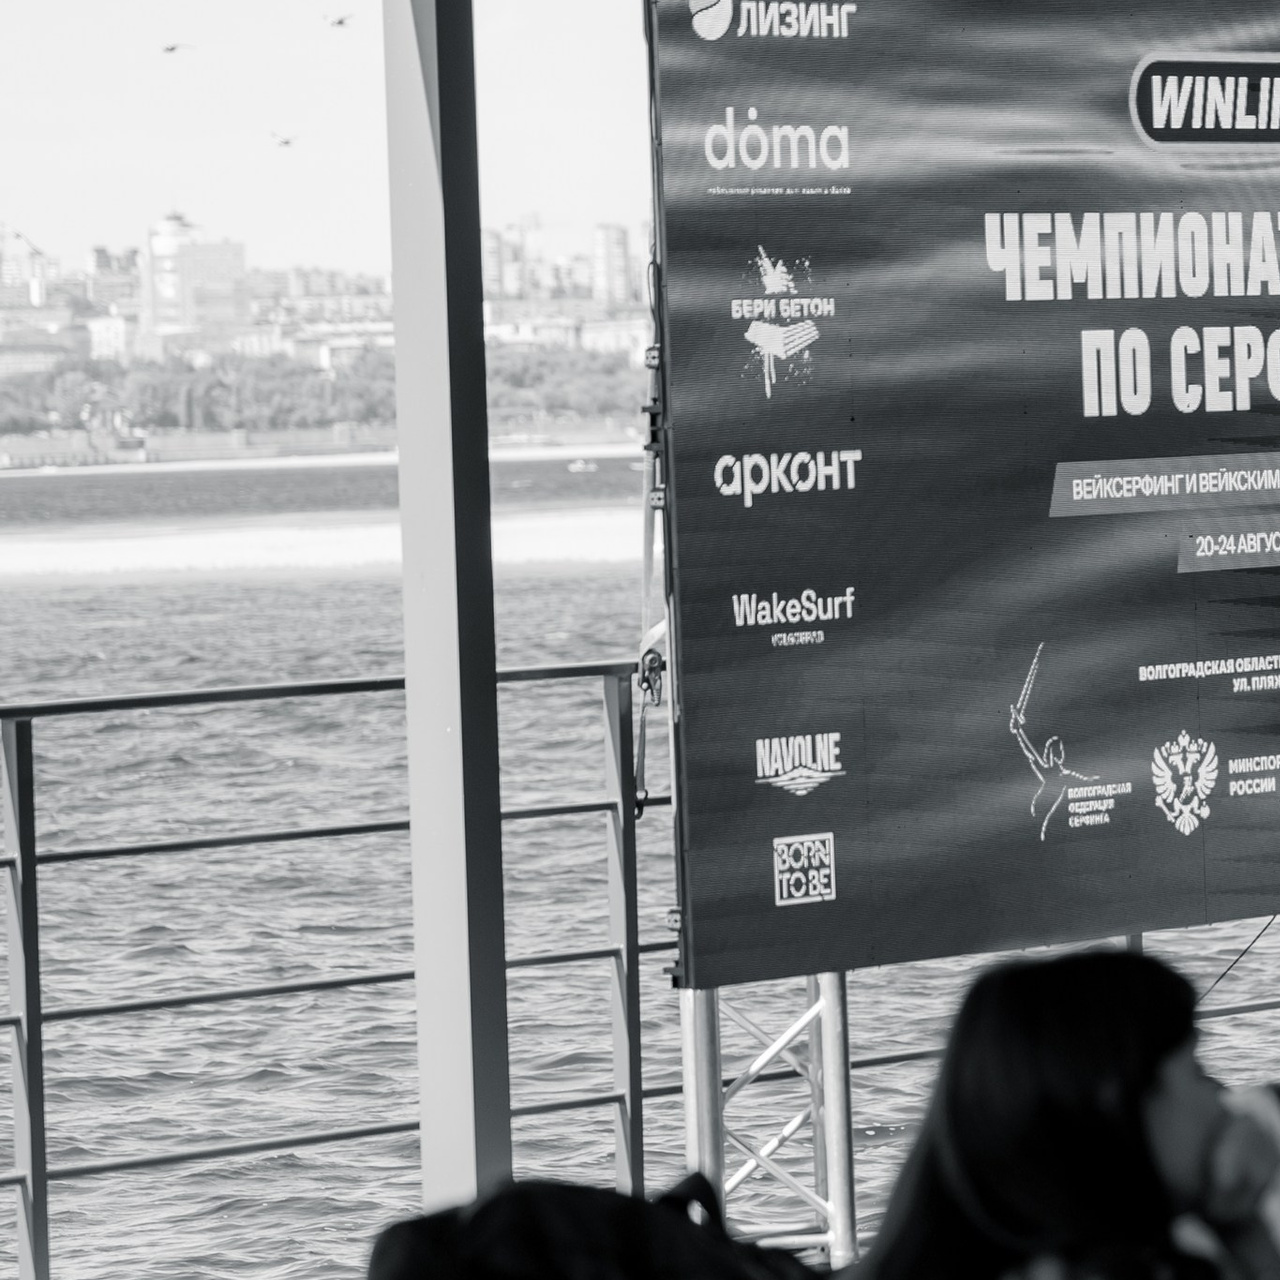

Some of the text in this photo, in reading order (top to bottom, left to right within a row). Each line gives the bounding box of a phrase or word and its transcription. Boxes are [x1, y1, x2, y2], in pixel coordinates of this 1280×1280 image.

[737, 1, 857, 37] ЛИЗИНГ
[731, 298, 835, 319] БЕРИ БЕТОН
[1081, 327, 1153, 417] ПО
[1072, 468, 1280, 500] ВЕЙКСЕРФИНГ И ВЕЙКСКИМ
[1195, 534, 1236, 557] 20-24
[732, 587, 855, 627] WakeSurf
[1139, 658, 1235, 682] ВОЛГОГРАДСКАЯ
[1232, 676, 1251, 693] УЛ.
[756, 732, 843, 778] NAVOLNE
[1229, 776, 1276, 797] РОССИИ
[777, 839, 831, 871] BORN
[778, 868, 831, 900] TO BE
